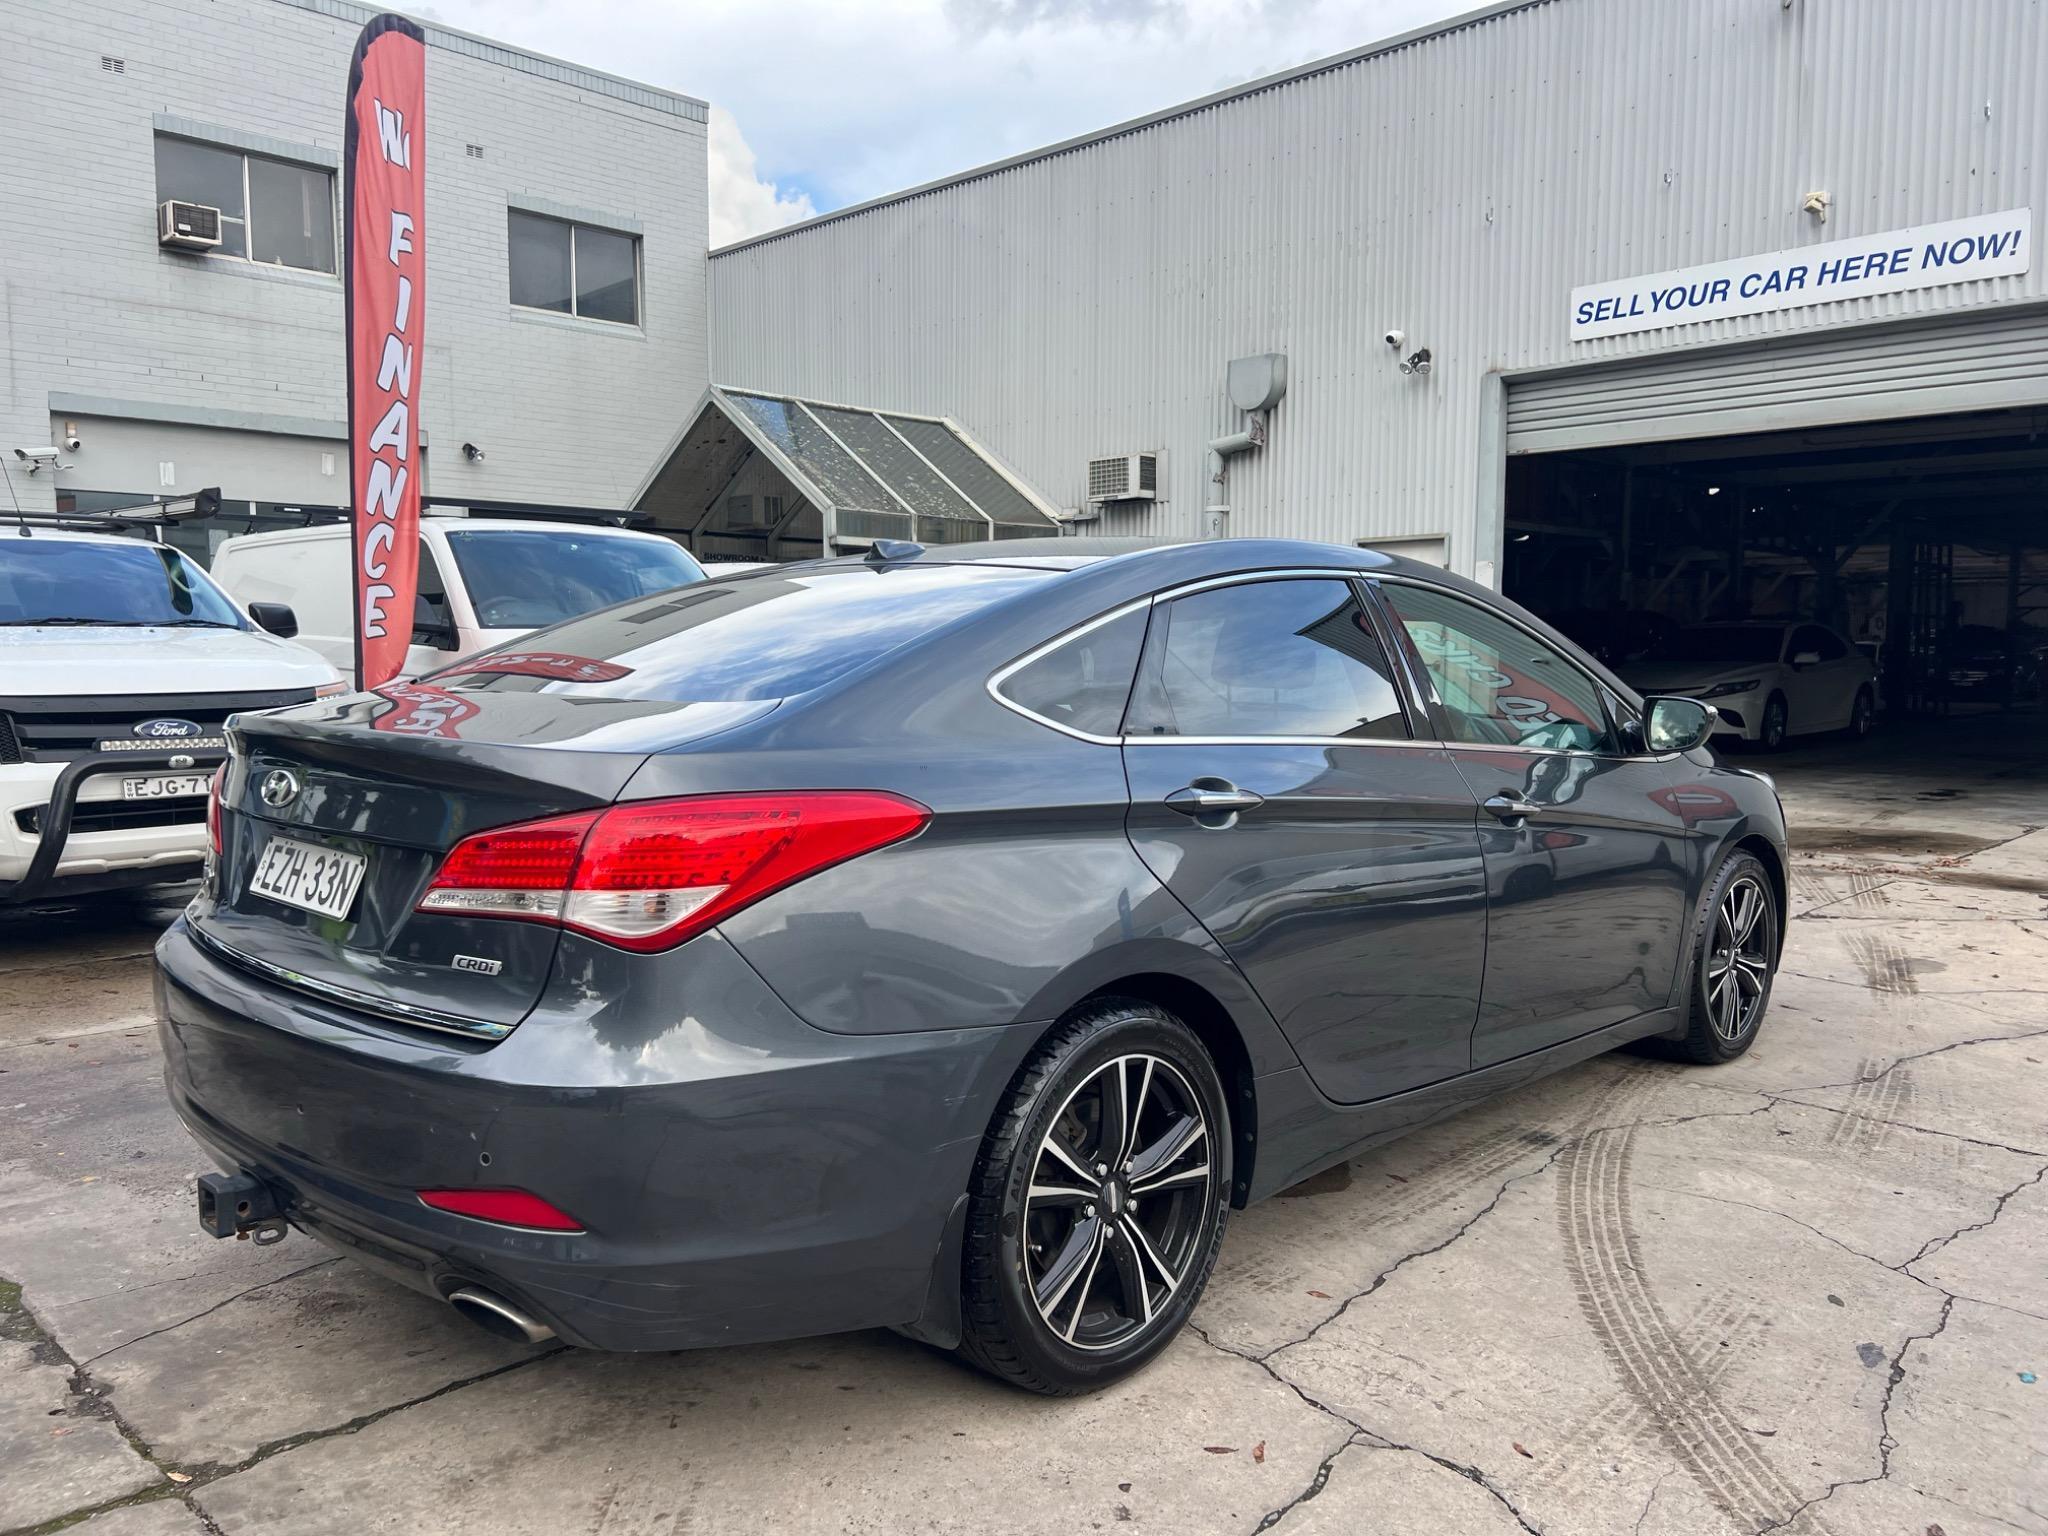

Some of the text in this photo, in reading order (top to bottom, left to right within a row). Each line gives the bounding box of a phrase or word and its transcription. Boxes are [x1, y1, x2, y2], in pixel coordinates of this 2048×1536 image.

[1575, 230, 2022, 325] SELL YOUR CAR HERE NOW!
[364, 209, 414, 639] FINANCE
[703, 552, 759, 562] SHOWROOM
[151, 721, 188, 736] Ford
[457, 957, 495, 973] CRDi
